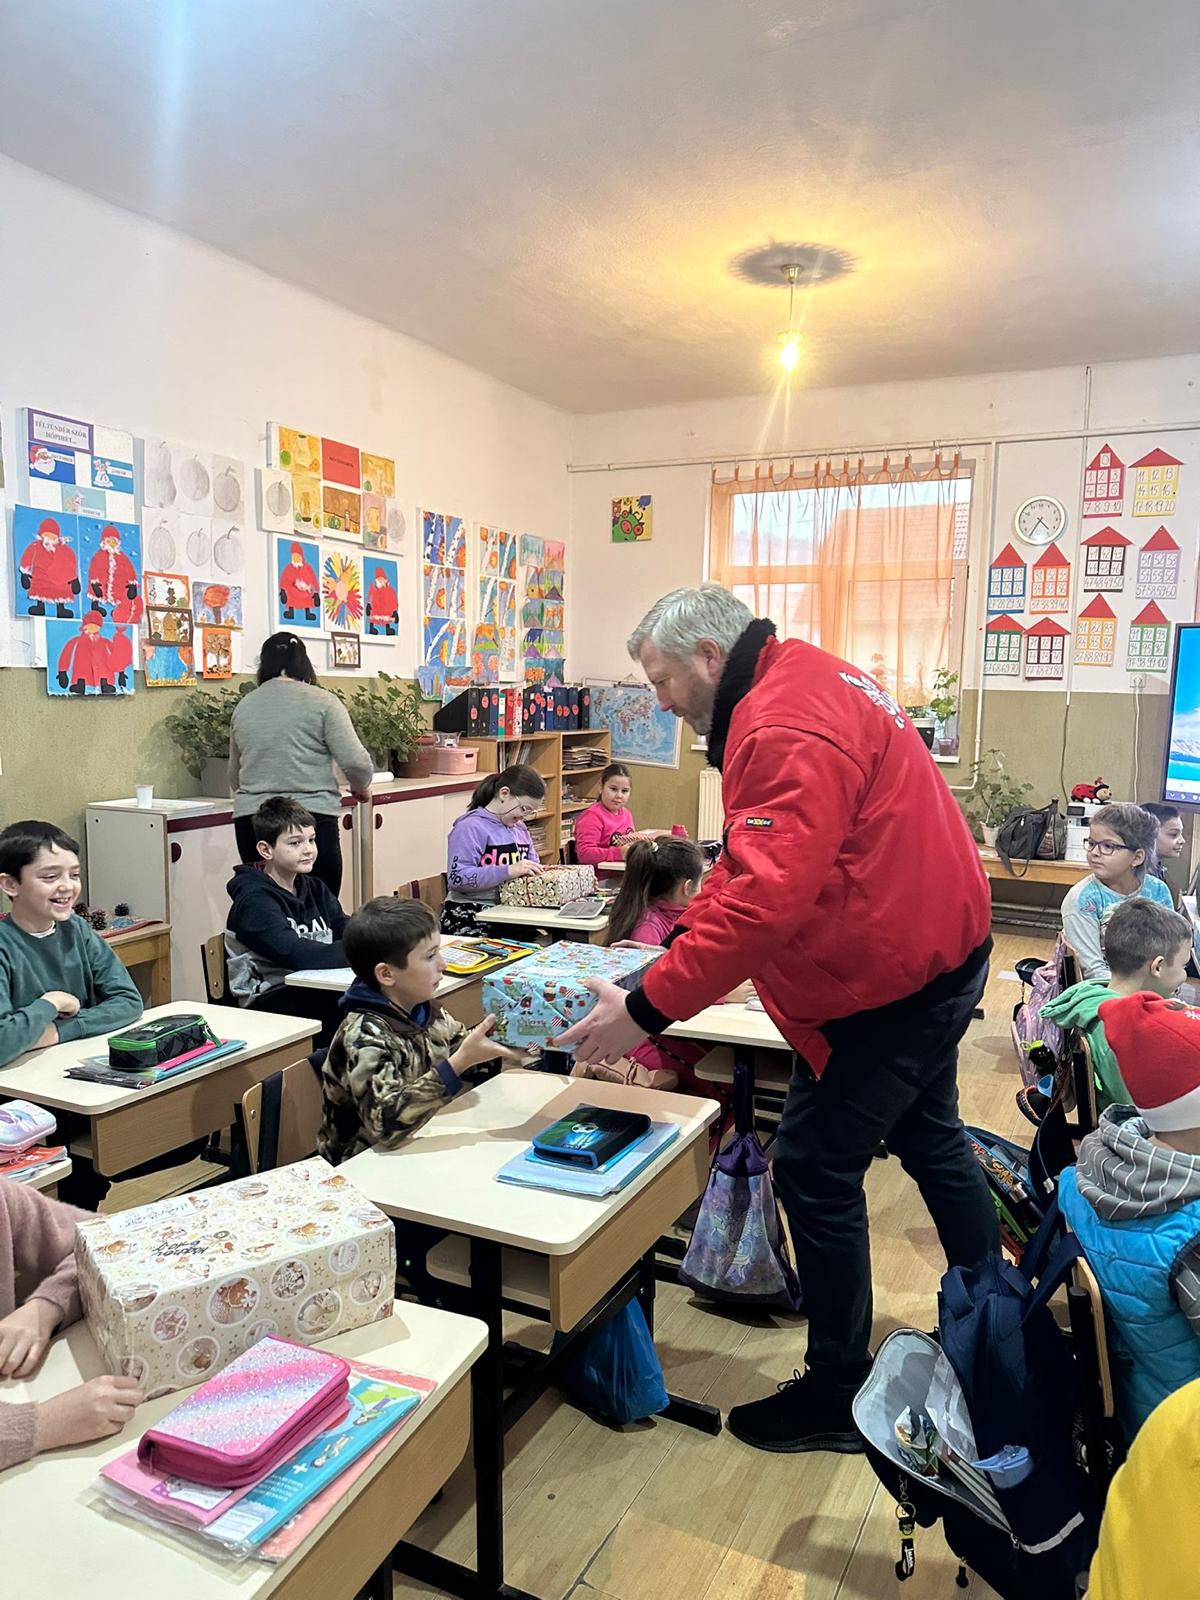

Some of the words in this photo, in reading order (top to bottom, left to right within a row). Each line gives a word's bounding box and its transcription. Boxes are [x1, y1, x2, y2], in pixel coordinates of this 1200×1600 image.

[1102, 455, 1109, 465] 0
[1088, 472, 1092, 481] 1
[1099, 471, 1104, 481] 2
[1087, 486, 1093, 496] 4
[1098, 485, 1105, 495] 5
[1111, 484, 1117, 495] 6
[1085, 502, 1092, 512] 7
[1095, 502, 1101, 512] 8
[1104, 502, 1110, 512] 9
[1114, 501, 1121, 511] 10
